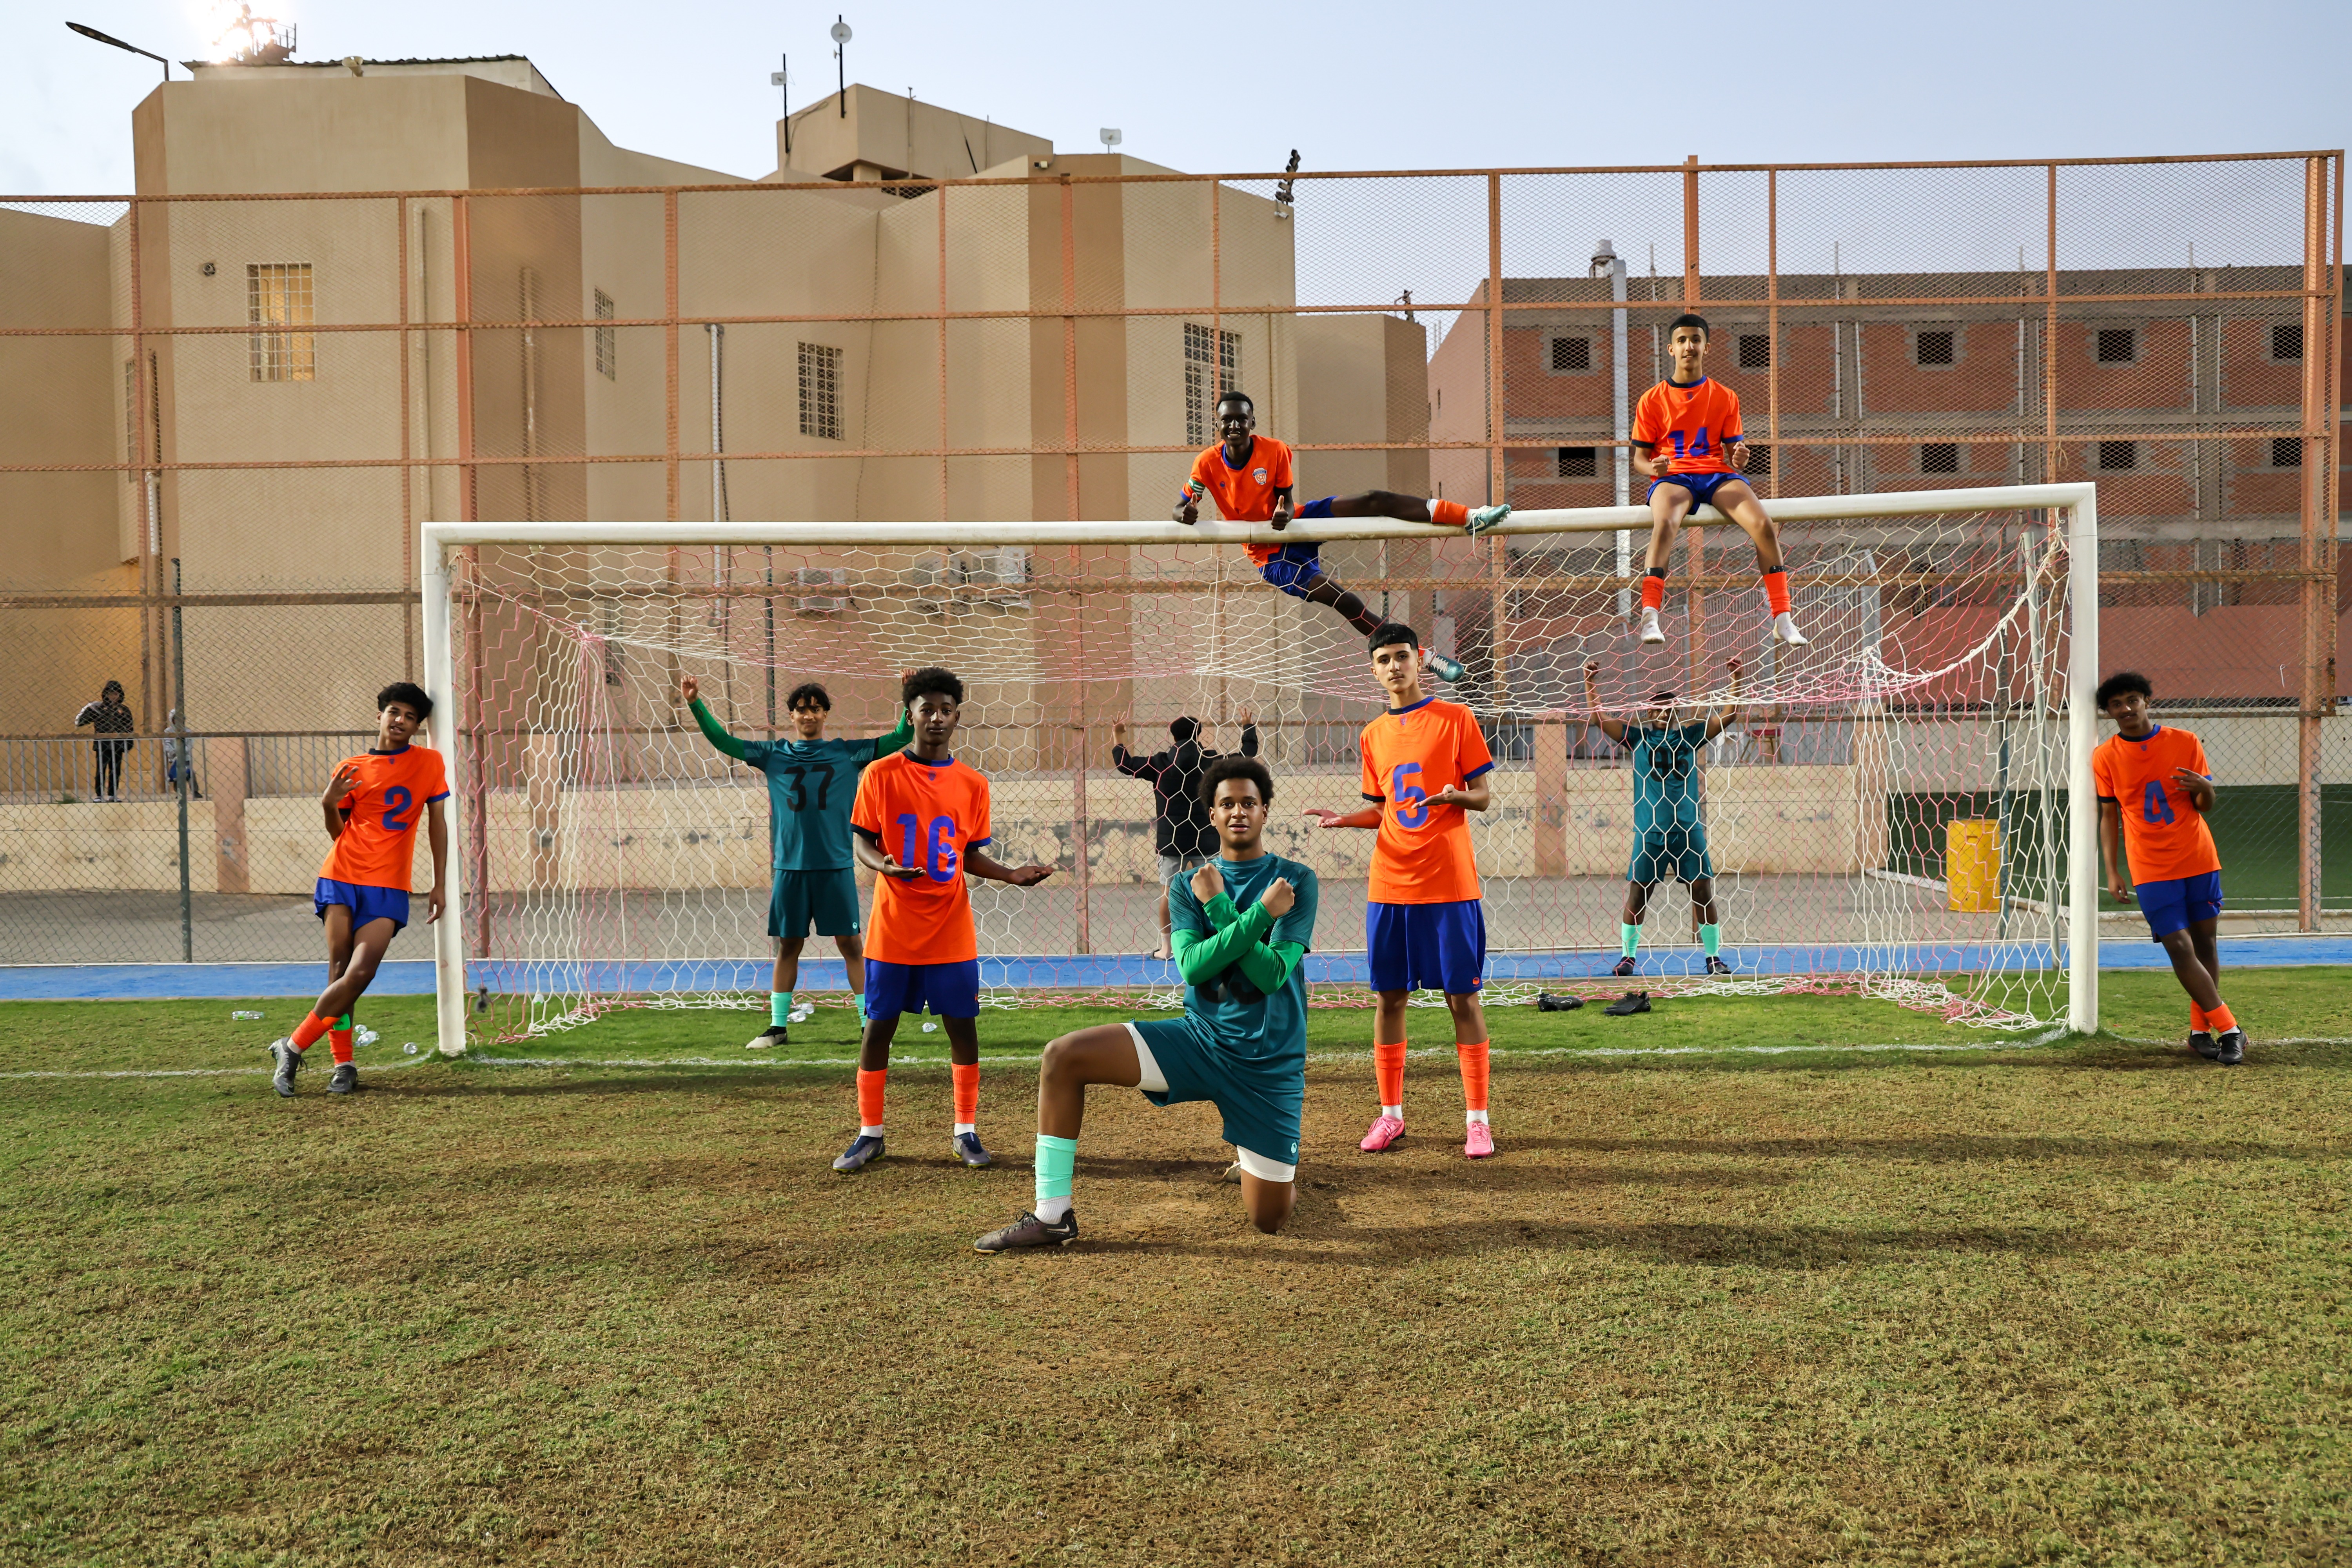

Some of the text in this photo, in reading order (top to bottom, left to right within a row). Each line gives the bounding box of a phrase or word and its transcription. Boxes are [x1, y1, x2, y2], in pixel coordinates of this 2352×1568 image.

[1668, 427, 1710, 458] 14
[1648, 746, 1689, 782] 96
[382, 786, 412, 830] 2
[783, 765, 835, 812] 37
[1393, 762, 1428, 828] 5
[2144, 780, 2175, 825] 4
[896, 813, 957, 882] 16
